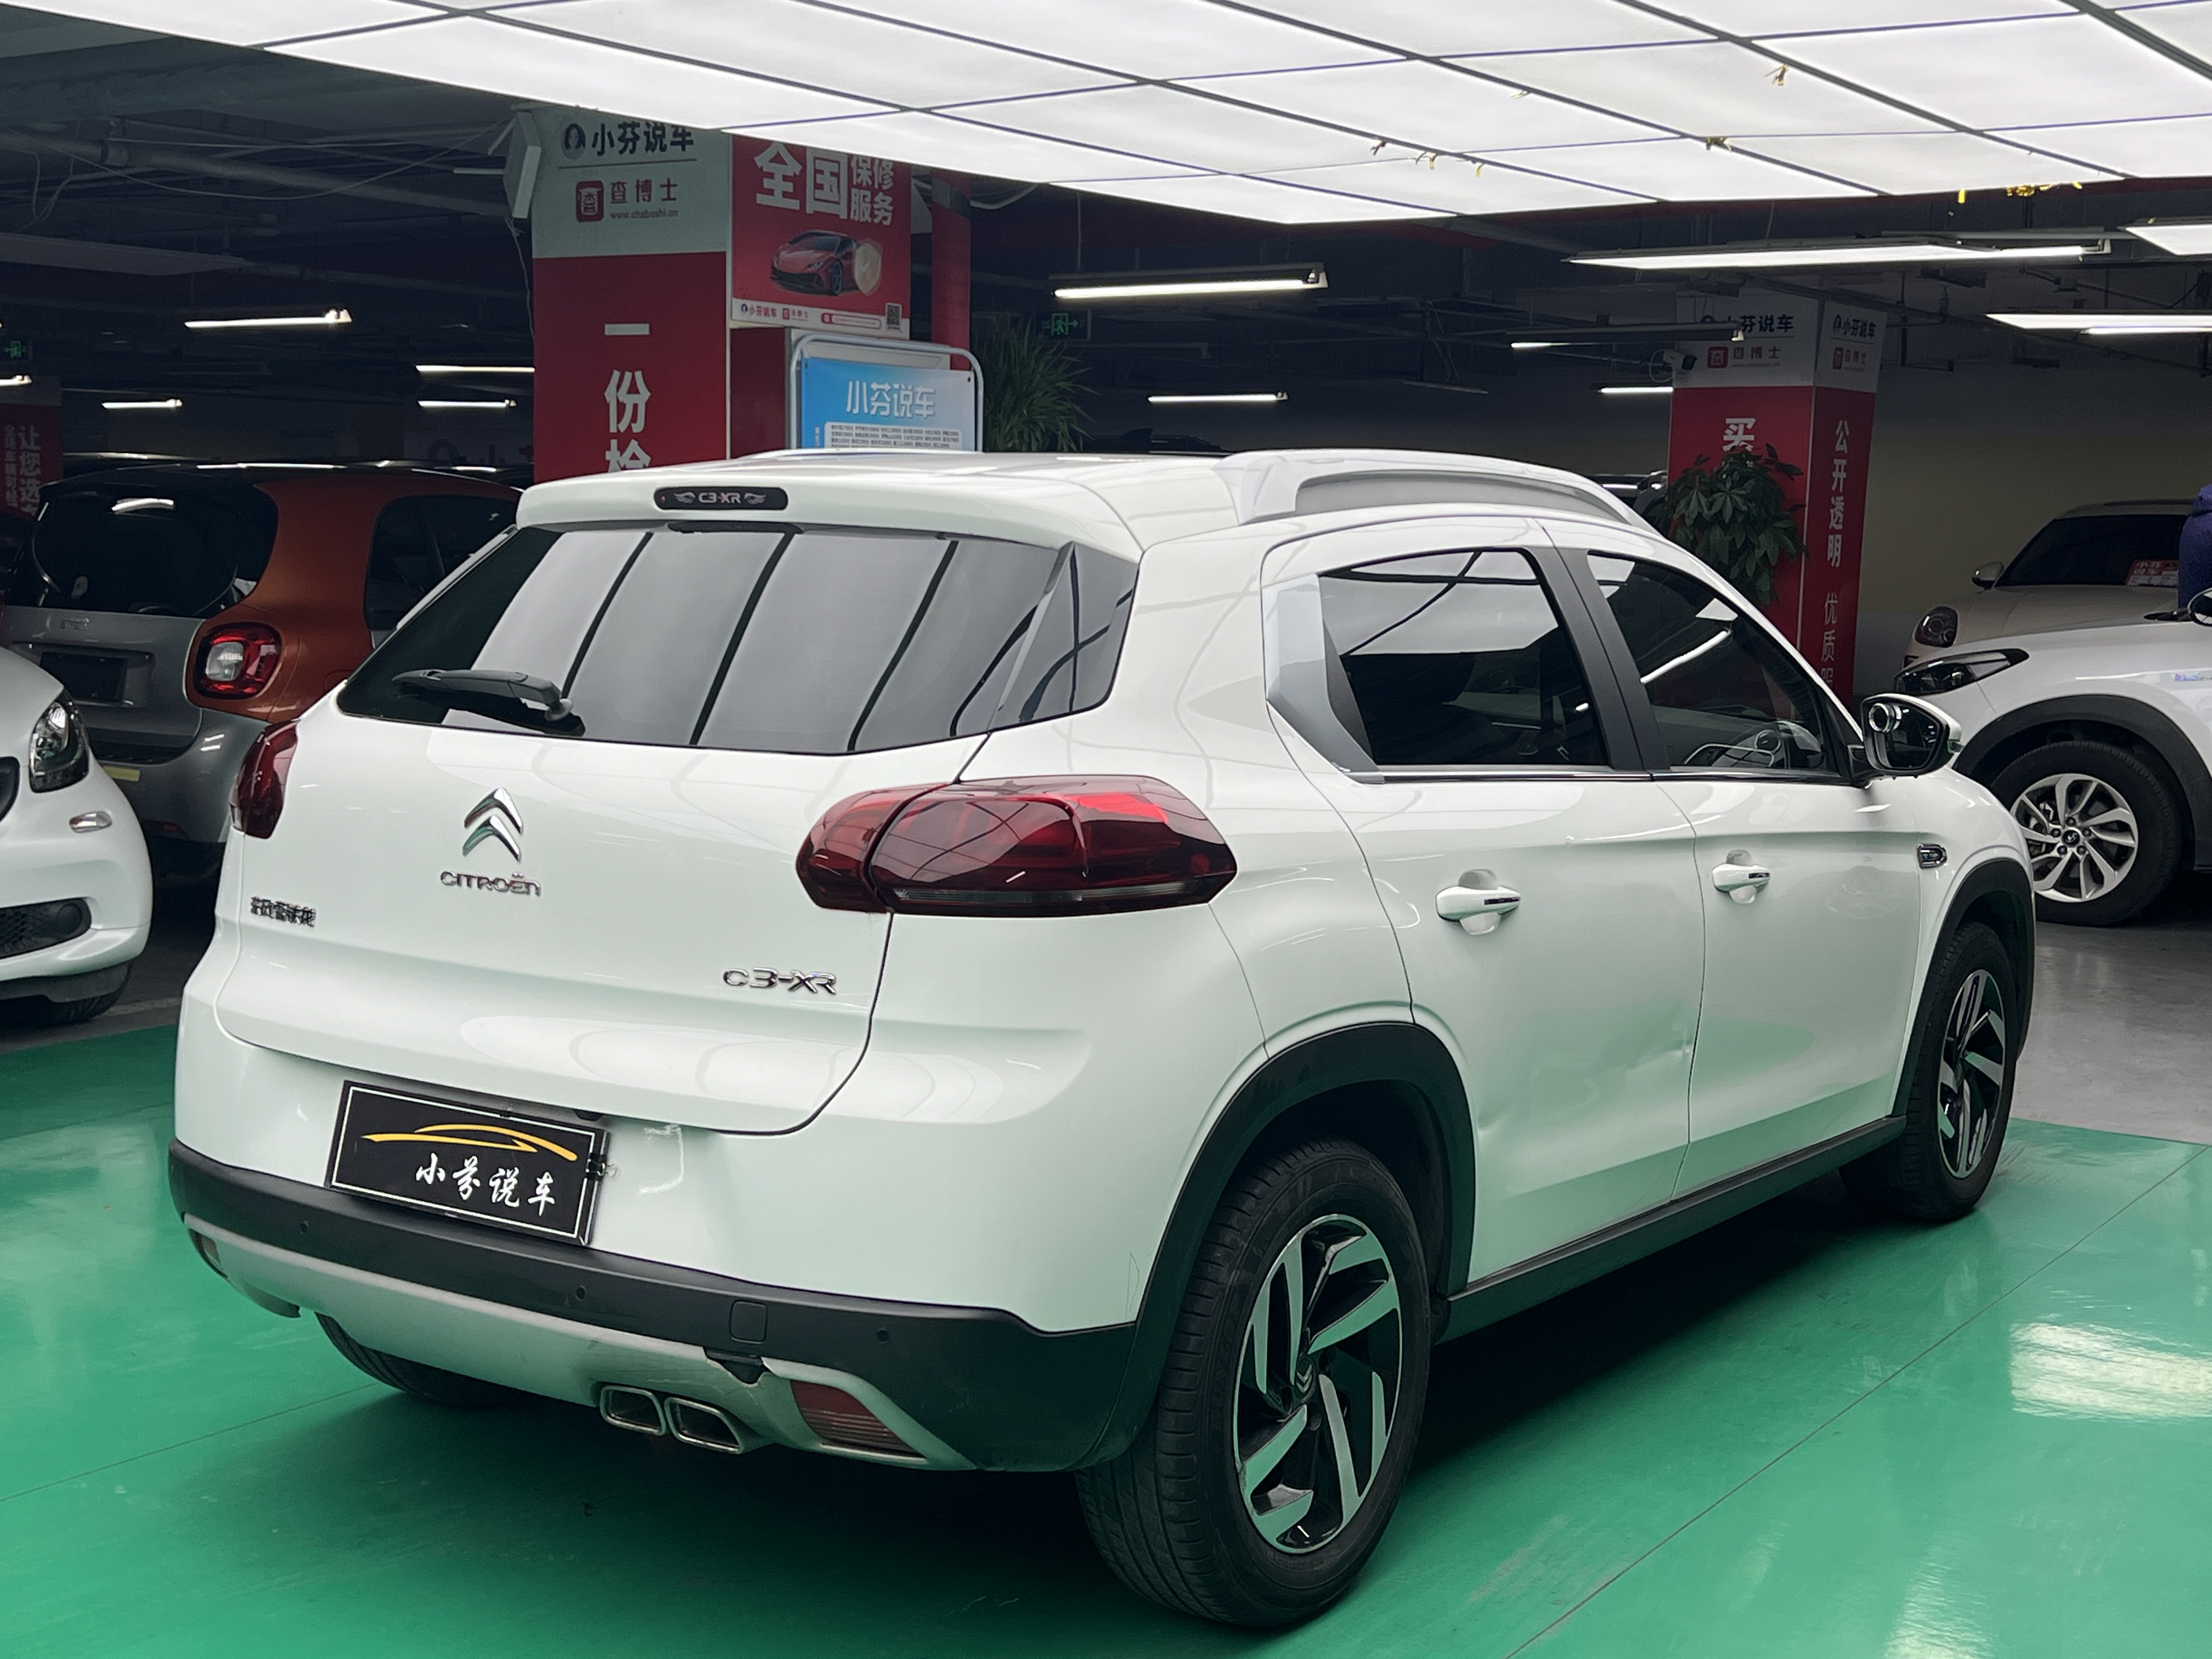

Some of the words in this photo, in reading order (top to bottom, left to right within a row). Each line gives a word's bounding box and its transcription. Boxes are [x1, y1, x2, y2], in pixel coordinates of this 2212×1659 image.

[591, 121, 694, 156] 小芬说车
[754, 143, 848, 219] 全国
[851, 156, 894, 190] 保修
[610, 178, 678, 204] 查博士
[851, 188, 894, 225] 服务
[610, 208, 678, 219] www.chaboshi.cn
[1728, 314, 1793, 332] 芬说车
[1842, 318, 1876, 338] 小芬说车
[846, 380, 936, 419] 小芬说车
[1827, 420, 1850, 567] 公开透明
[723, 967, 837, 995] C3-XR
[415, 1153, 556, 1217] 小芬说车
